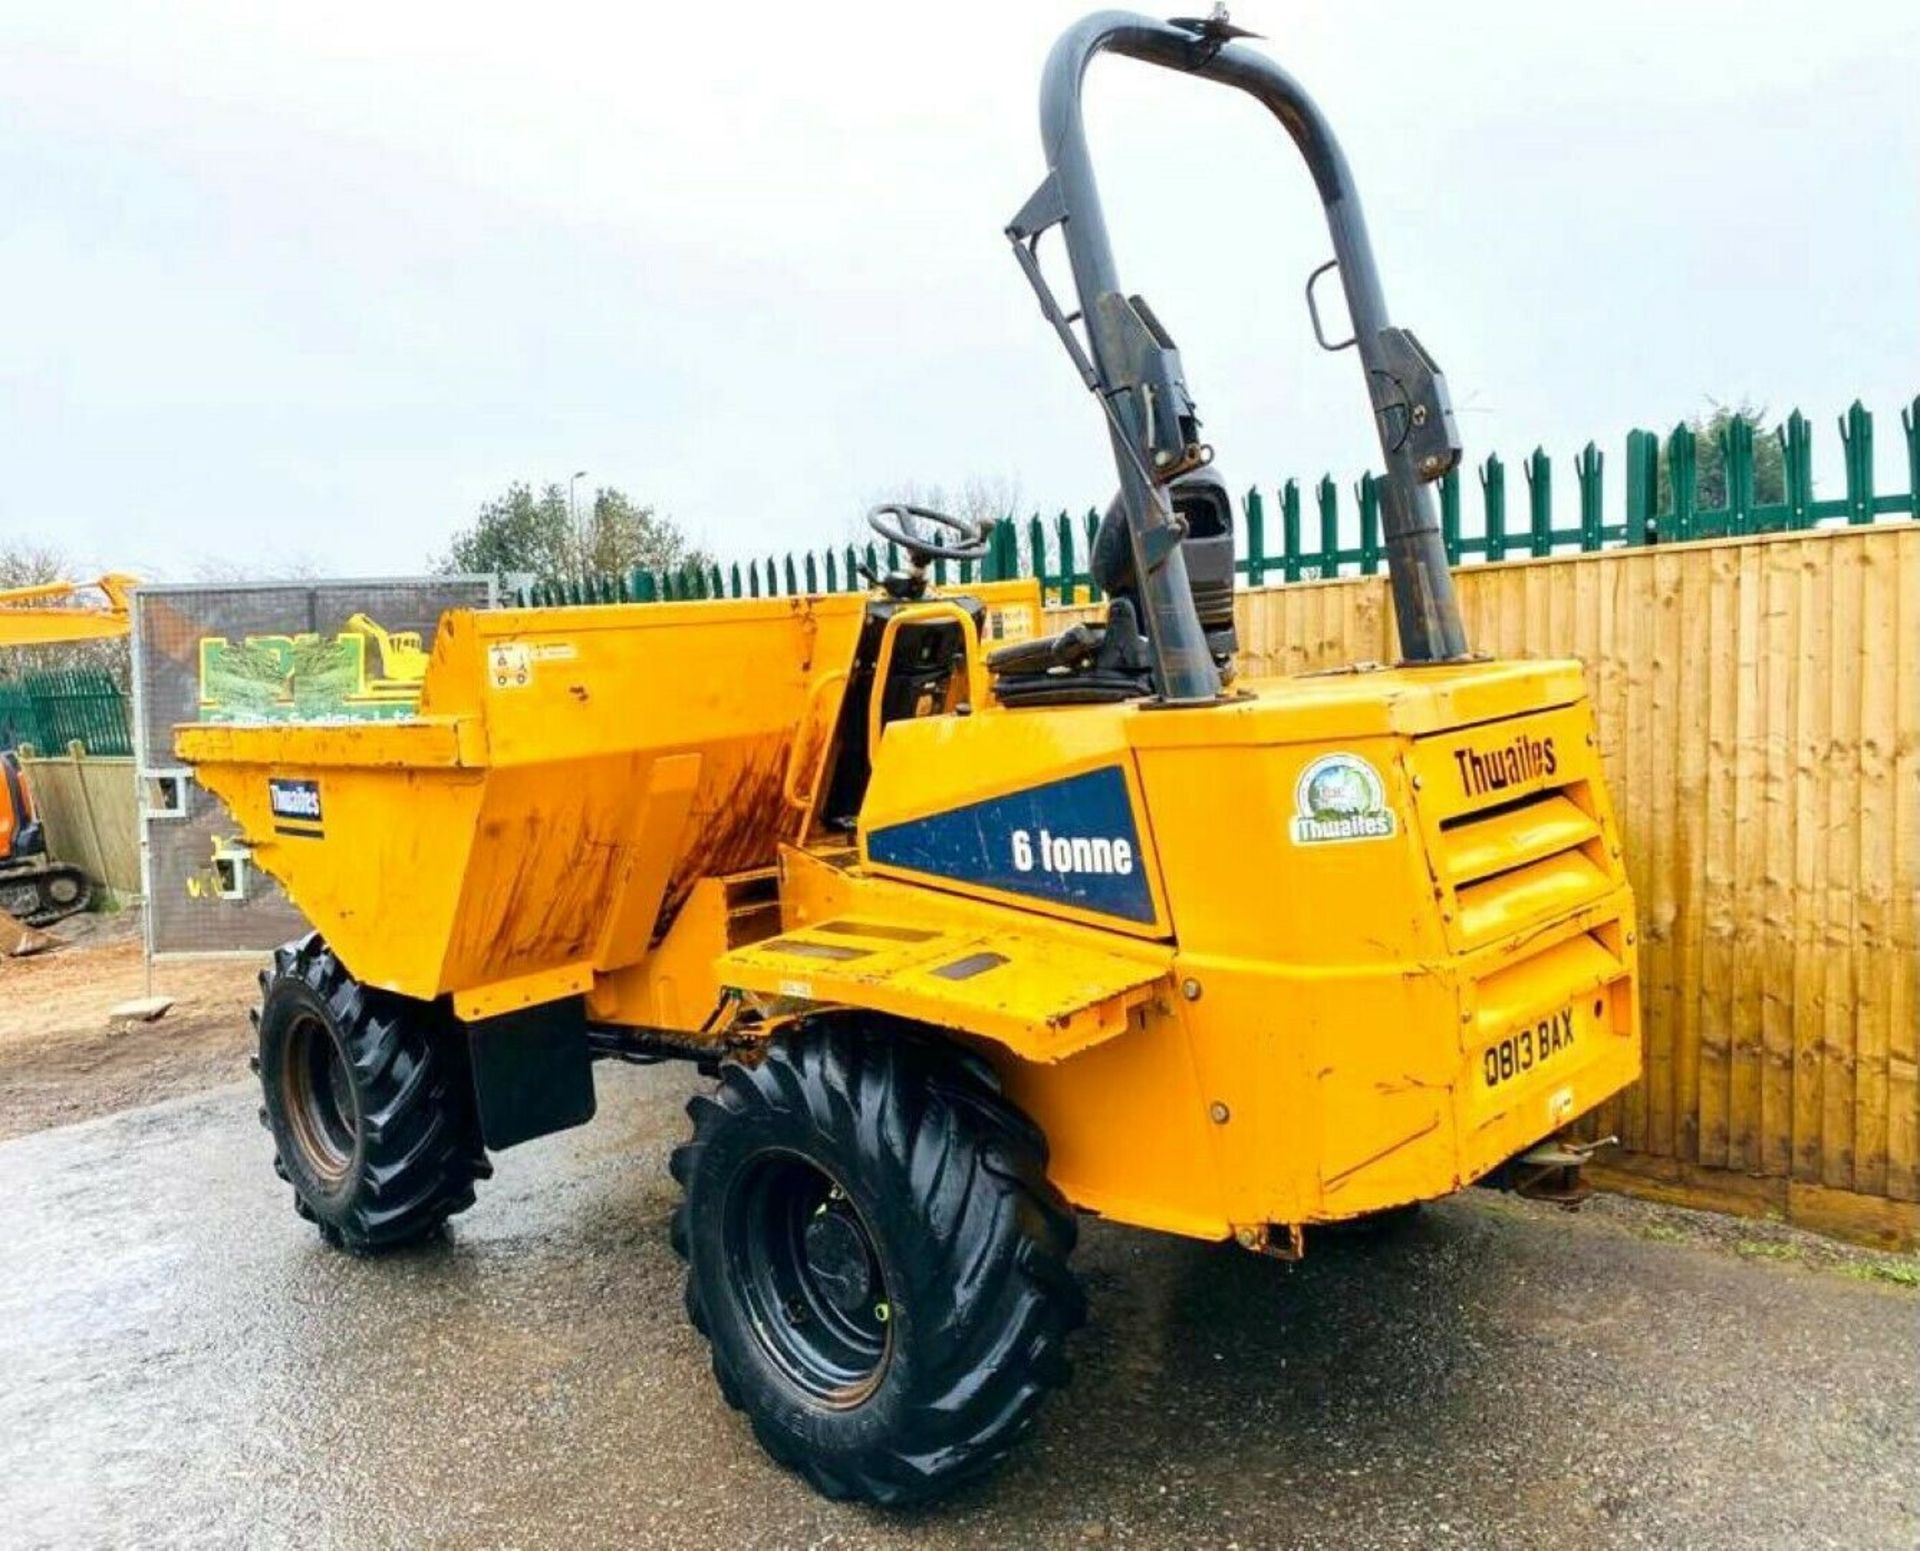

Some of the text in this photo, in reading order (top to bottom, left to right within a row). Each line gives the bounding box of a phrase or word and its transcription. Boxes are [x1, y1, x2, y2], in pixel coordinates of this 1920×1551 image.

[1454, 735, 1556, 798] Thwaites
[1012, 829, 1132, 875] 6 tonne
[1299, 814, 1389, 841] Thwaites
[1537, 1007, 1574, 1062] BAX
